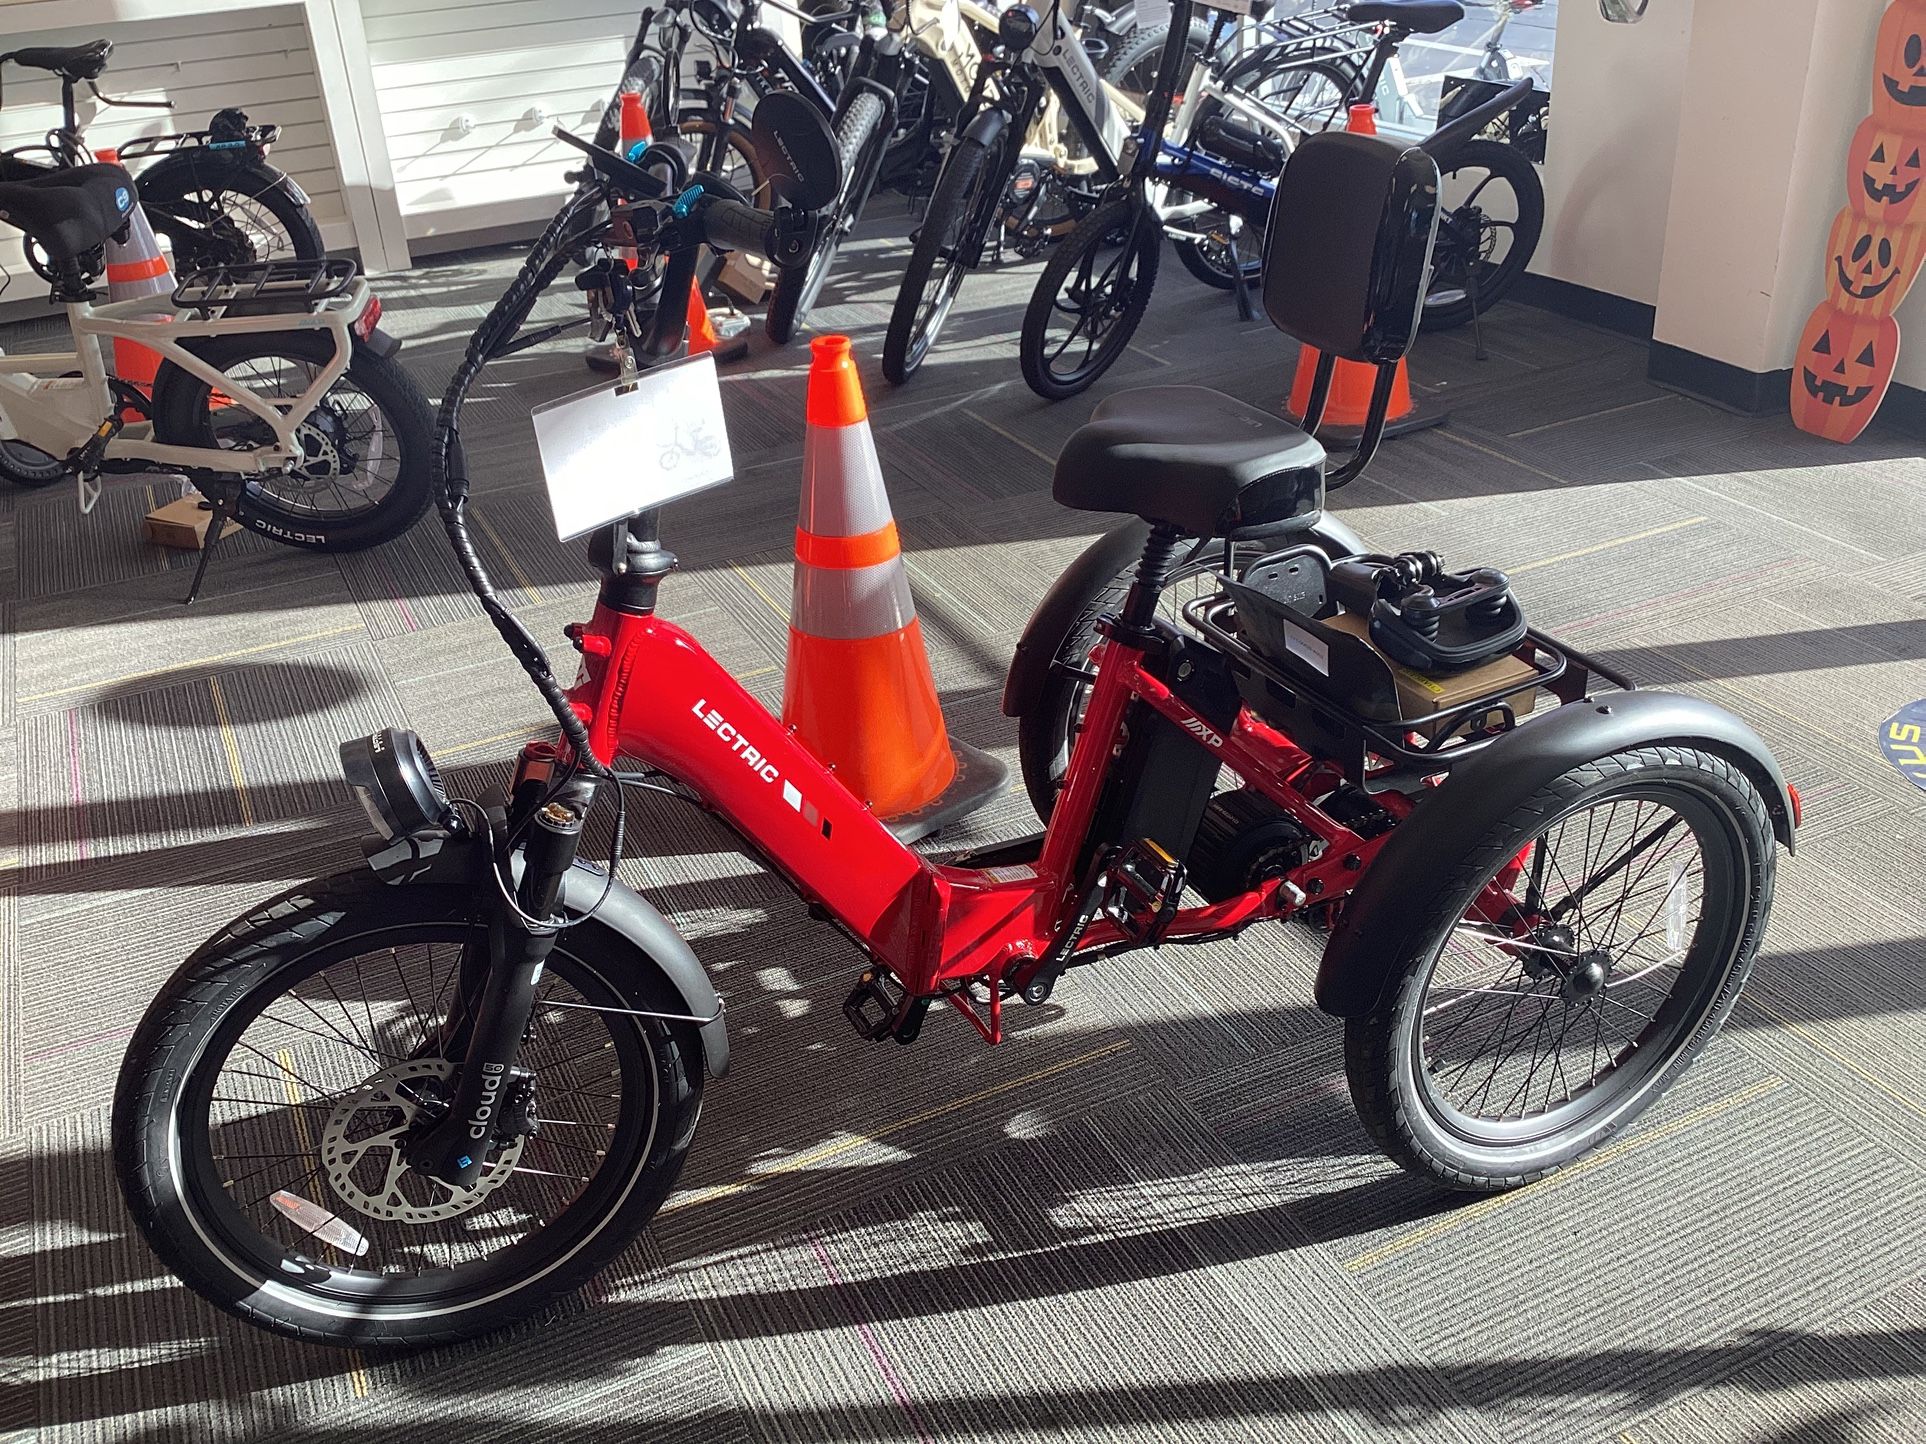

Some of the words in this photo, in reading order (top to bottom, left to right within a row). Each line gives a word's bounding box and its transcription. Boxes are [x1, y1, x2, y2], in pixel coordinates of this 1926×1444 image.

[1062, 50, 1095, 104] LECTRIC
[774, 130, 805, 182] LECTRIC
[255, 519, 326, 544] LECTRIC
[691, 698, 780, 783] LECTRIC
[1055, 914, 1089, 962] LECTRIC
[468, 1075, 502, 1139] cloud
